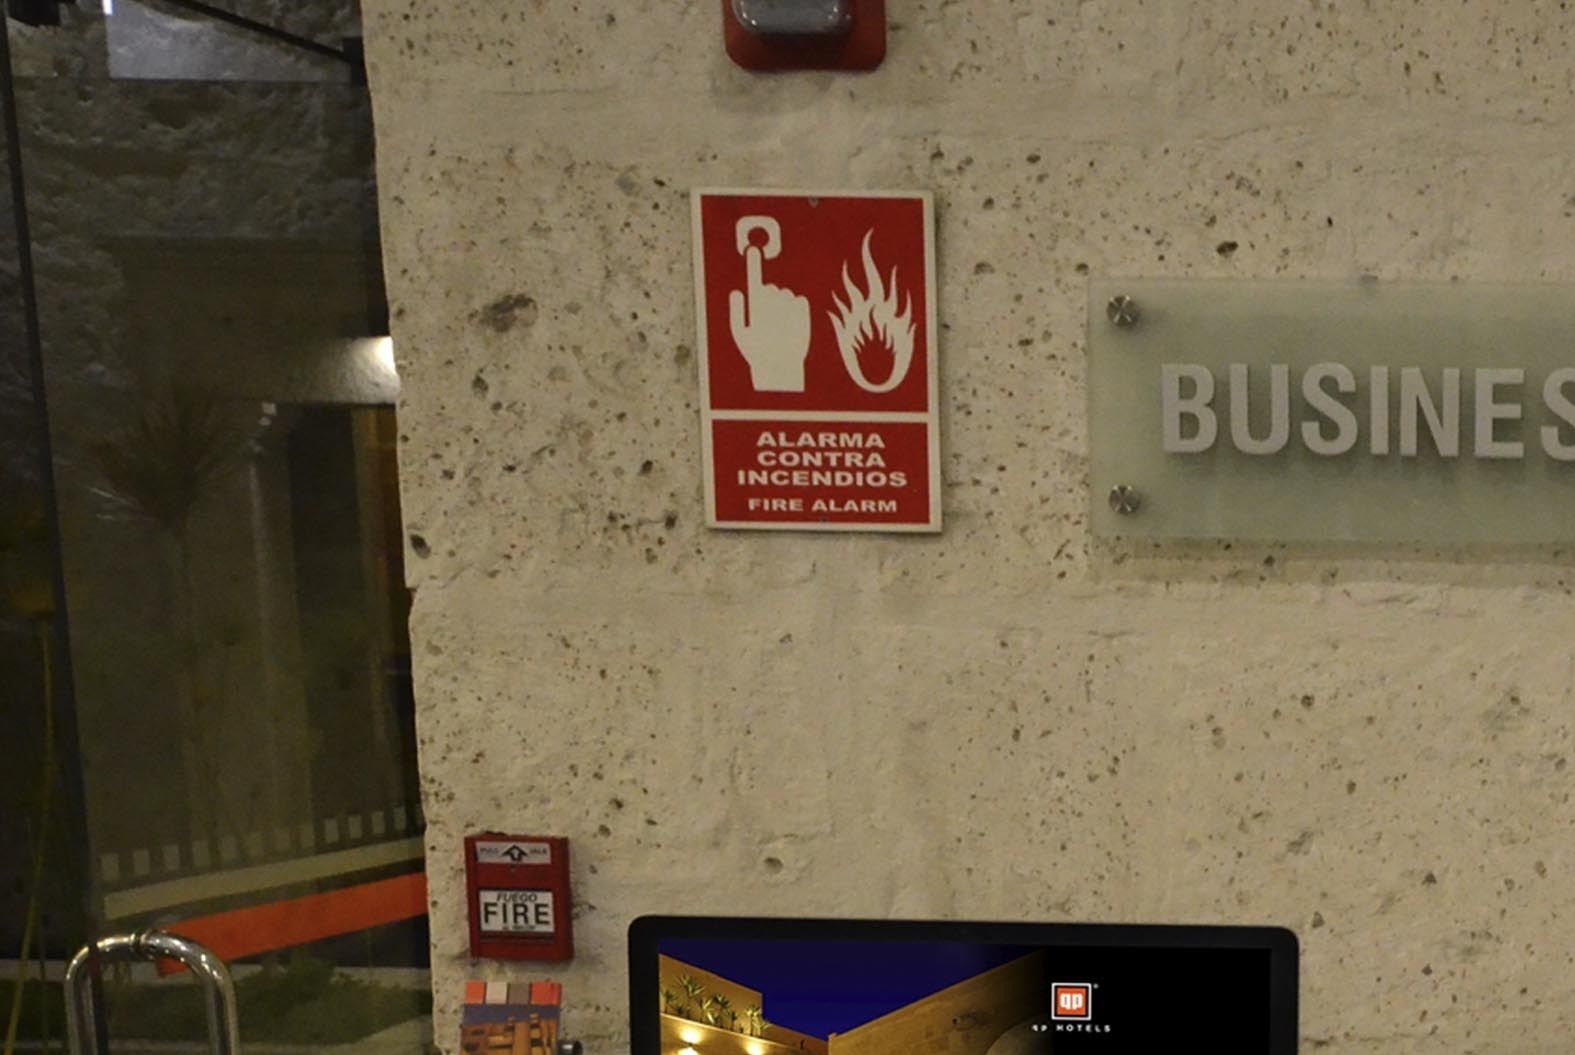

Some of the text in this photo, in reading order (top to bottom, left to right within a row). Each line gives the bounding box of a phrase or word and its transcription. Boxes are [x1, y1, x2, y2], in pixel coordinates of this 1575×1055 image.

[756, 431, 886, 449] ALARMA
[757, 451, 886, 468] CONTRA
[737, 470, 908, 487] INCENDIOS
[748, 498, 898, 513] FIRE ALARM
[496, 892, 538, 902] FUEGO
[483, 902, 550, 924] FIRE
[1056, 1024, 1111, 1033] HOTELS
